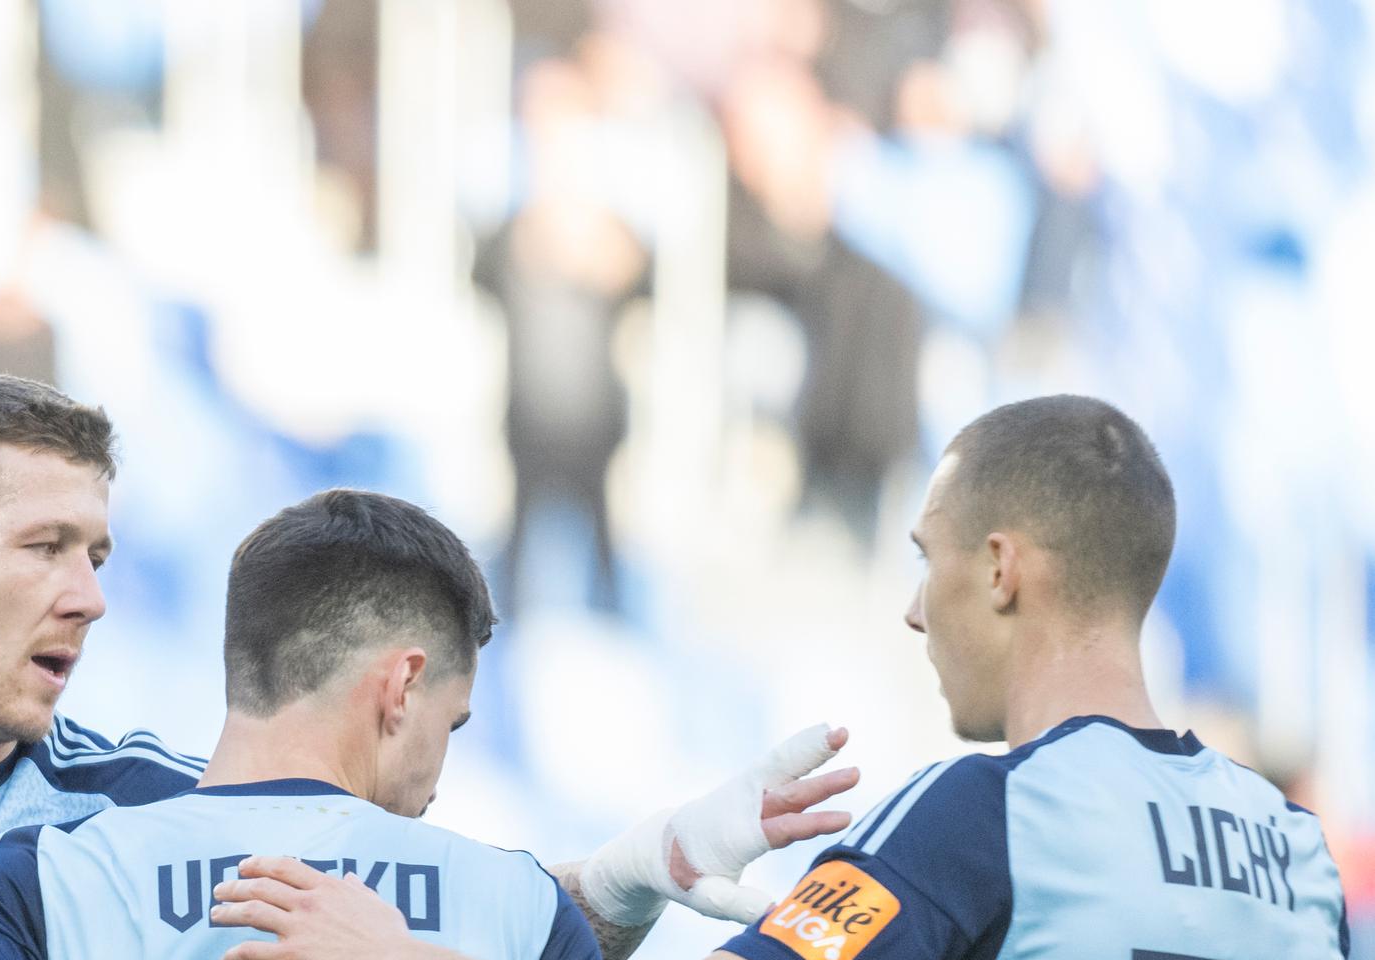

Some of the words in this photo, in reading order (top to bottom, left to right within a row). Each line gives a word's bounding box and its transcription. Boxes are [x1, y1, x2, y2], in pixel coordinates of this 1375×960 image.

[1146, 801, 1295, 912] LICHÝ
[771, 903, 847, 960] LIGA
[793, 880, 881, 934] niké
